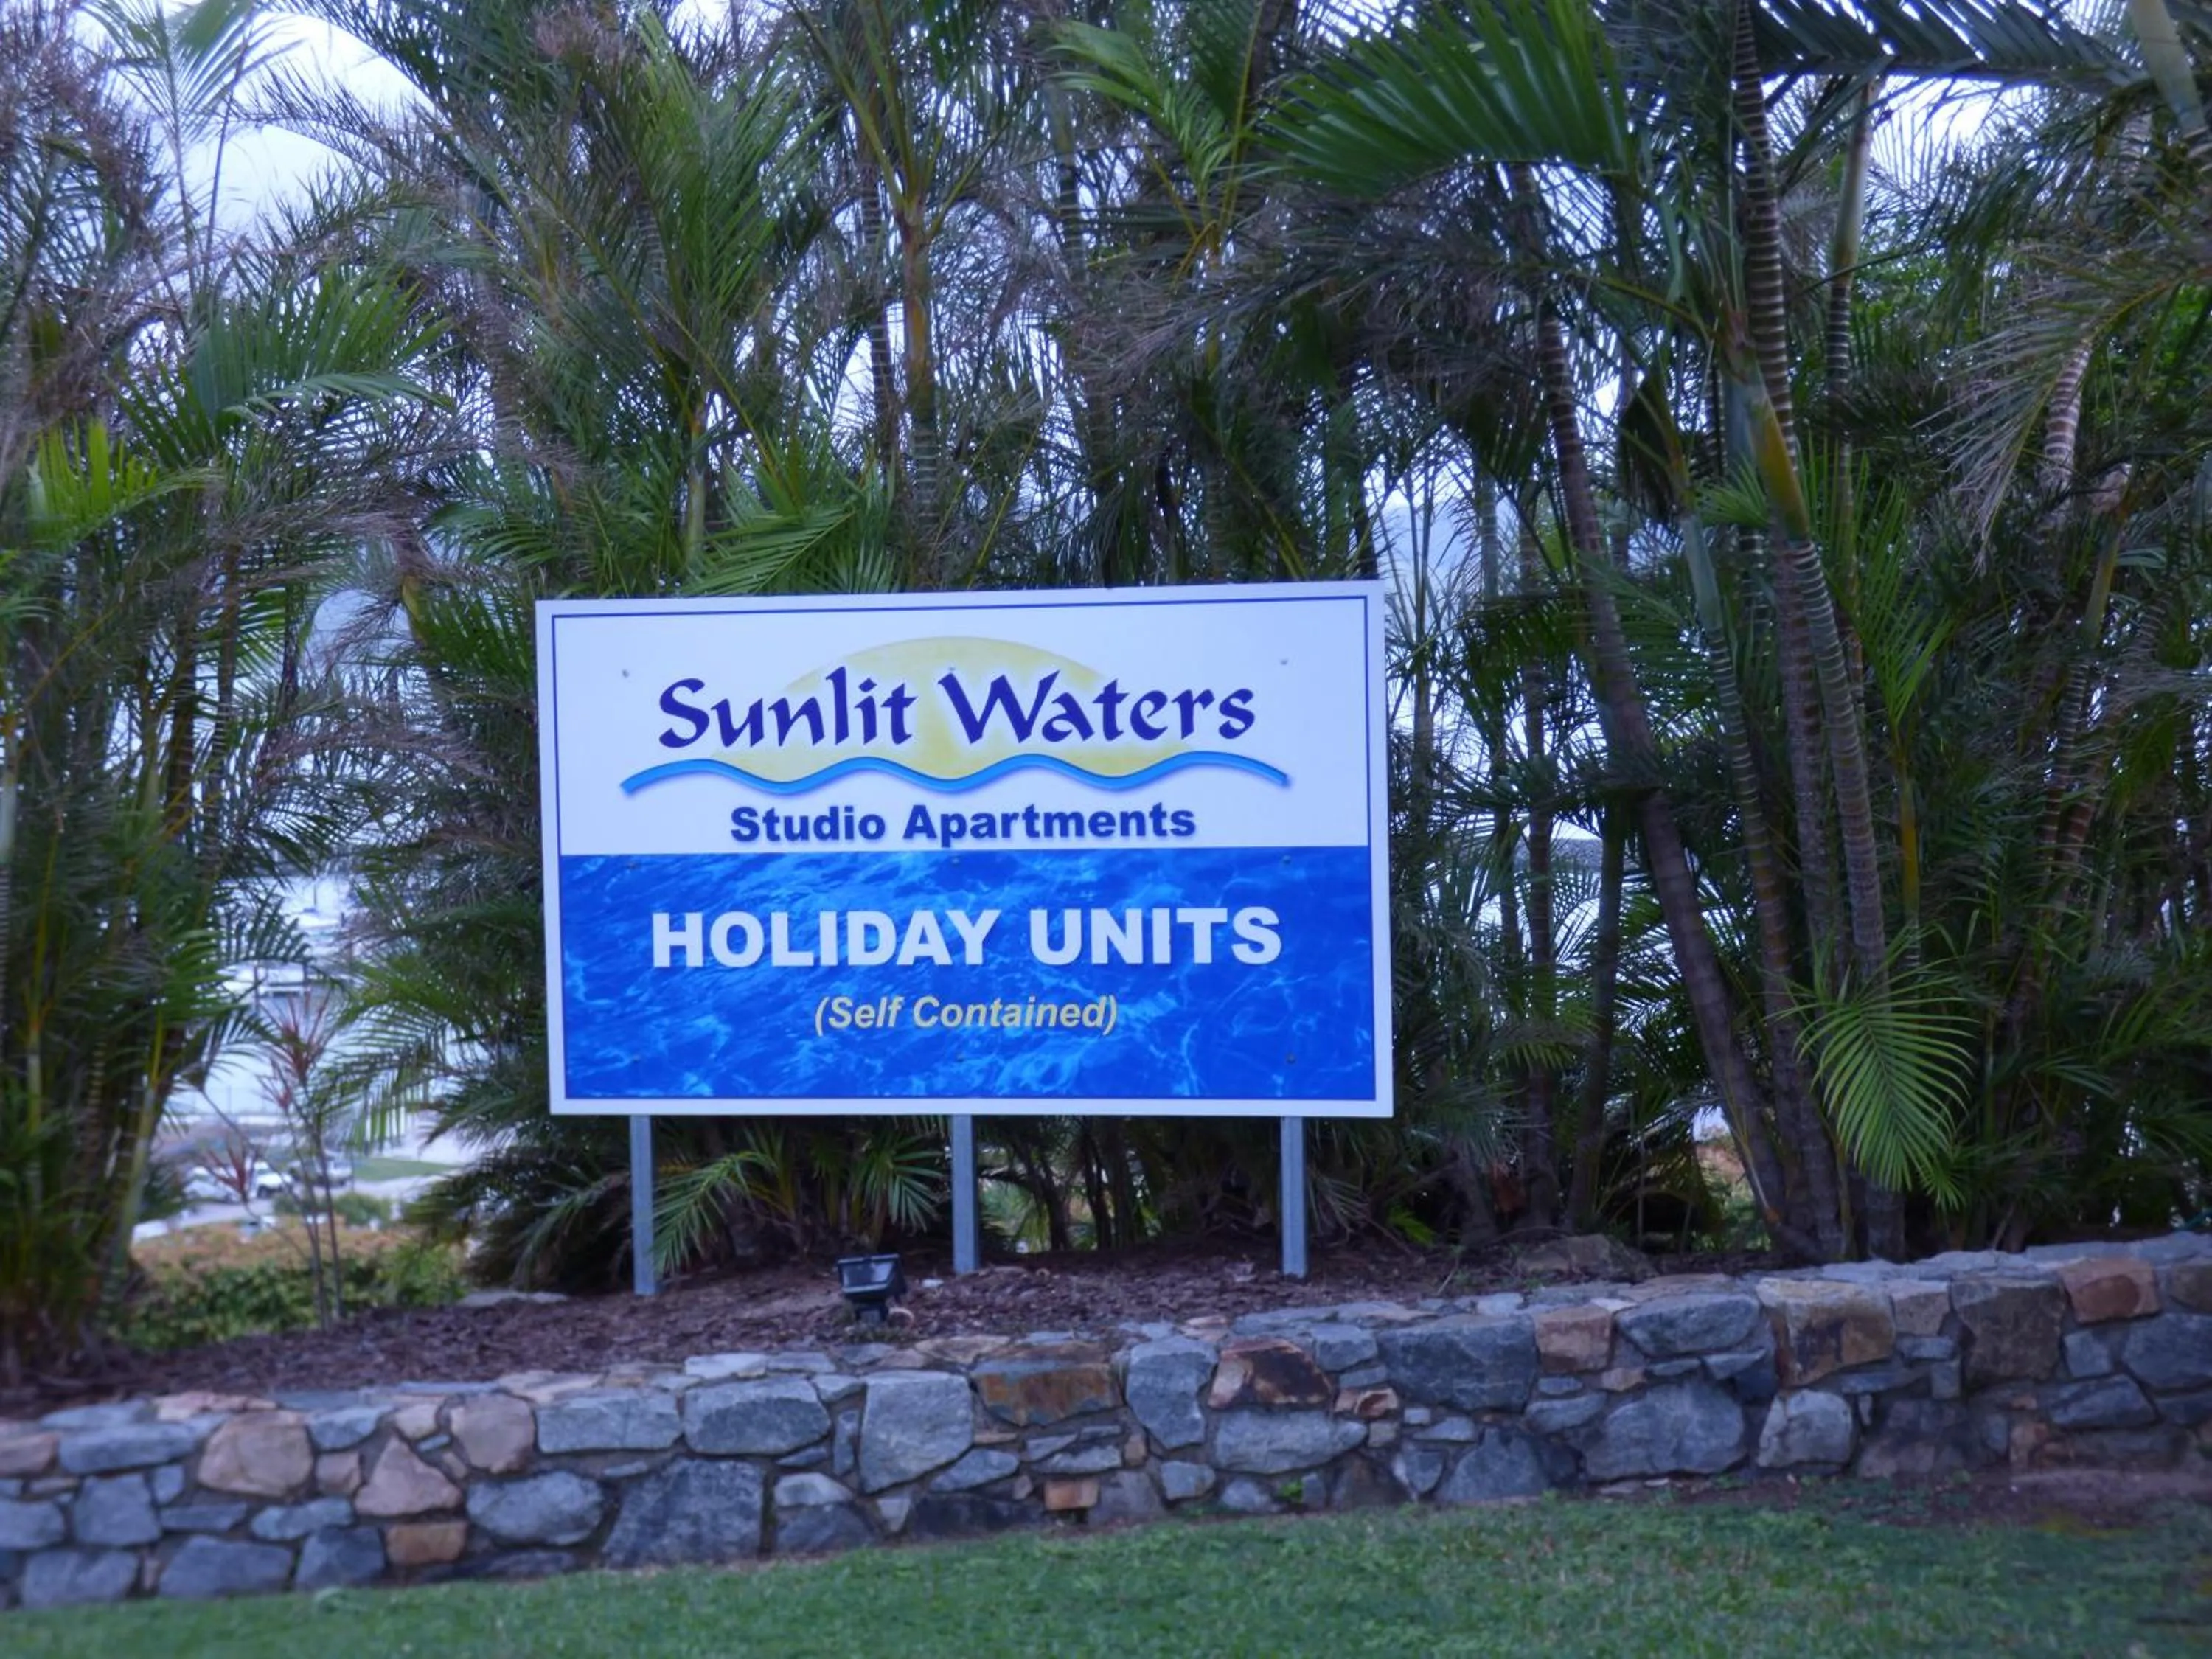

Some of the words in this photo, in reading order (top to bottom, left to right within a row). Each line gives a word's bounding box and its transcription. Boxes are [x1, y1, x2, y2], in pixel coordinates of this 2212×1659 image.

[658, 666, 917, 748] Sunlit
[937, 668, 1256, 745] Waters
[730, 806, 886, 844] Studio
[903, 801, 1195, 849] Apartments
[651, 908, 1000, 968] HOLIDAY
[1029, 906, 1281, 966] UNITS
[814, 995, 905, 1037] (Self
[913, 994, 1118, 1035] Contained)
